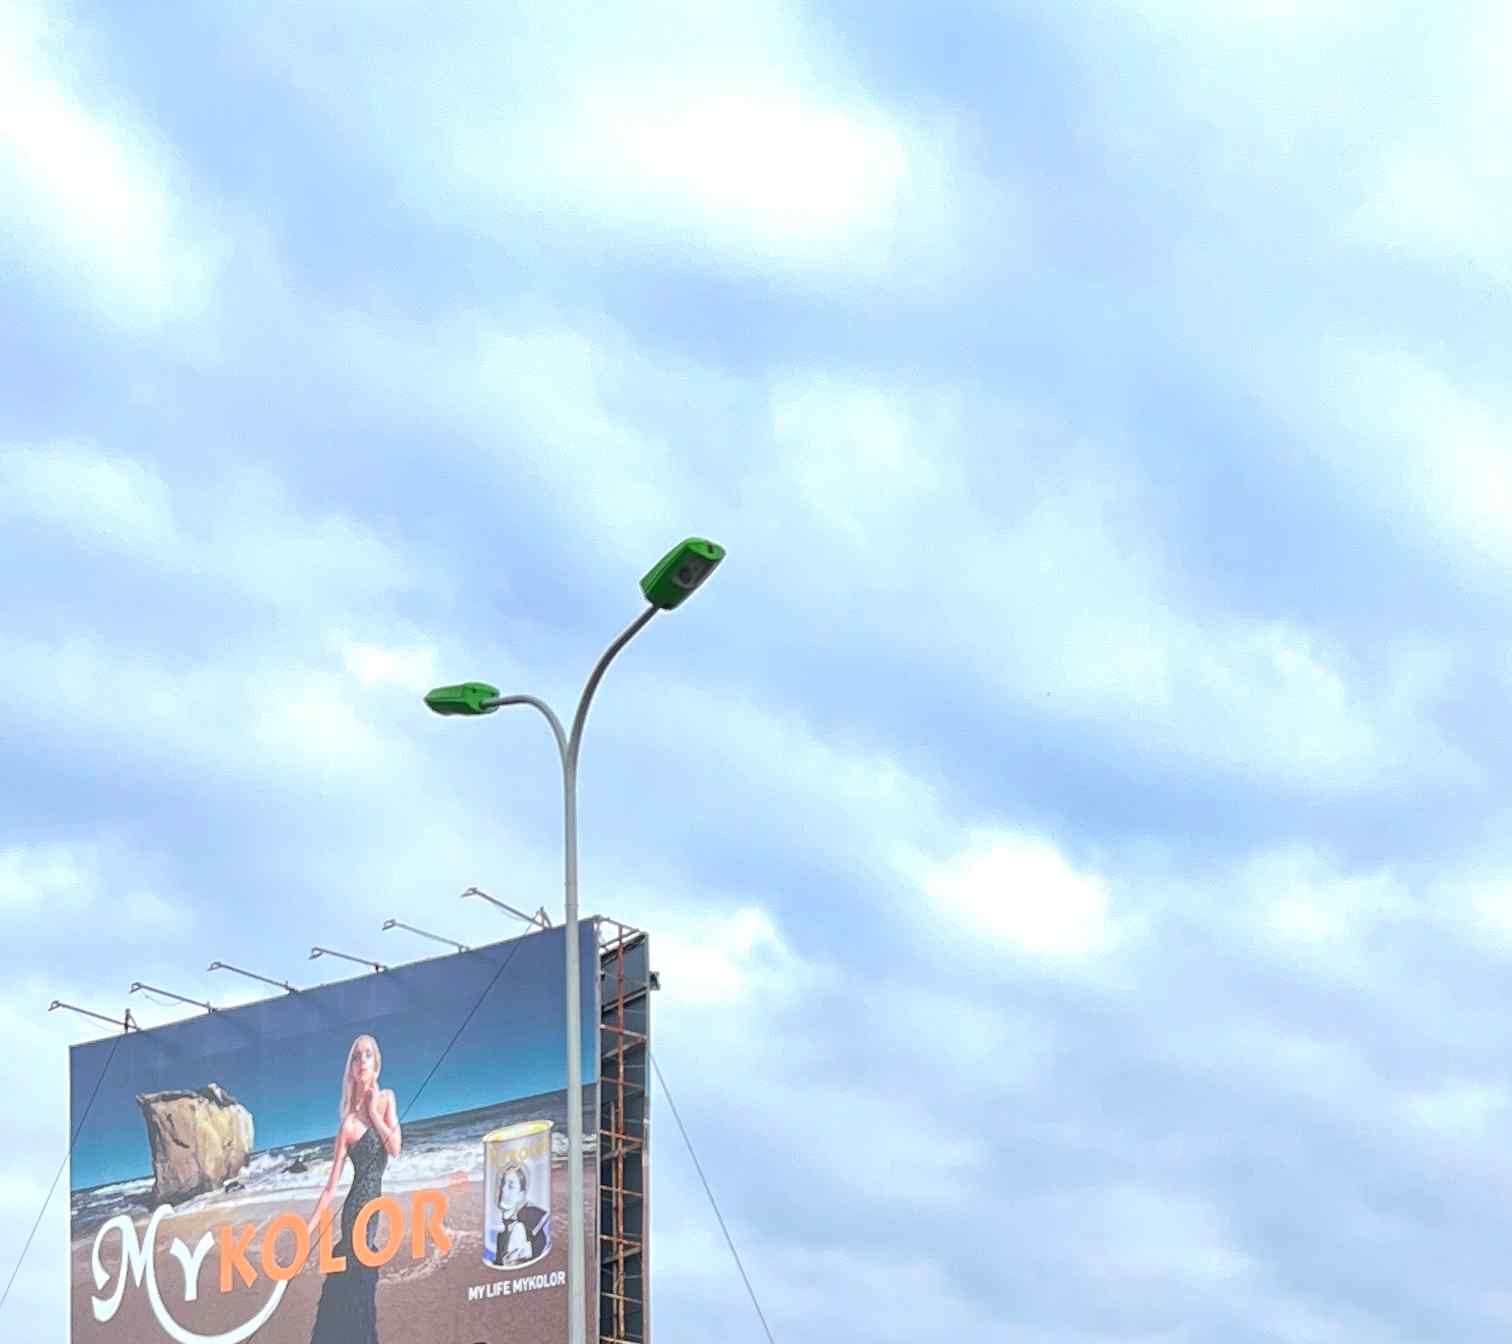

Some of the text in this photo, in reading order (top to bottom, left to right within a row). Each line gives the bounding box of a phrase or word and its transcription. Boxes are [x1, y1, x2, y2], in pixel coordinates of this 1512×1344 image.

[468, 1271, 566, 1301] MY LIFE MYKOLOR
